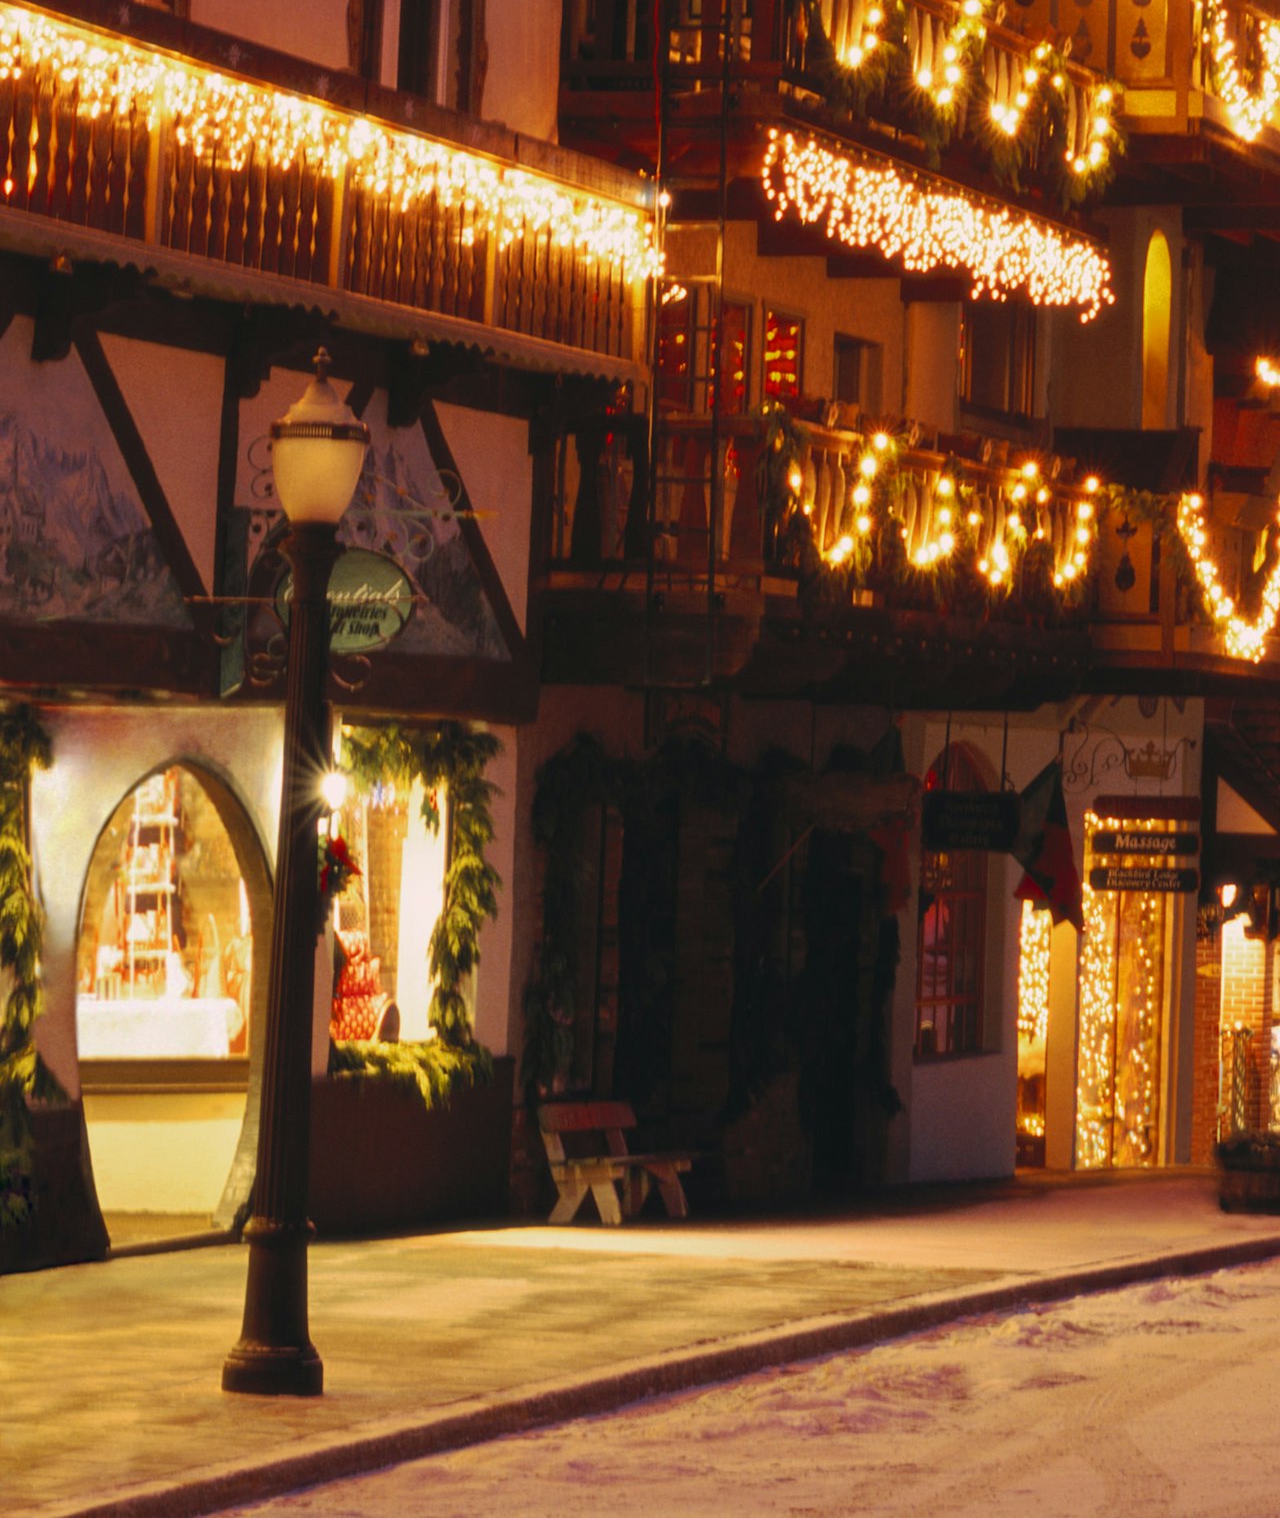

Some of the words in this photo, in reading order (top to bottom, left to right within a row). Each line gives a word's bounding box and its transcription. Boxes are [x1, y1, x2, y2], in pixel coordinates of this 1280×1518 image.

[1115, 834, 1176, 853] Massage
[1108, 868, 1151, 878] Blackbird
[1107, 878, 1151, 888] Discovery
[1152, 879, 1181, 889] Center
